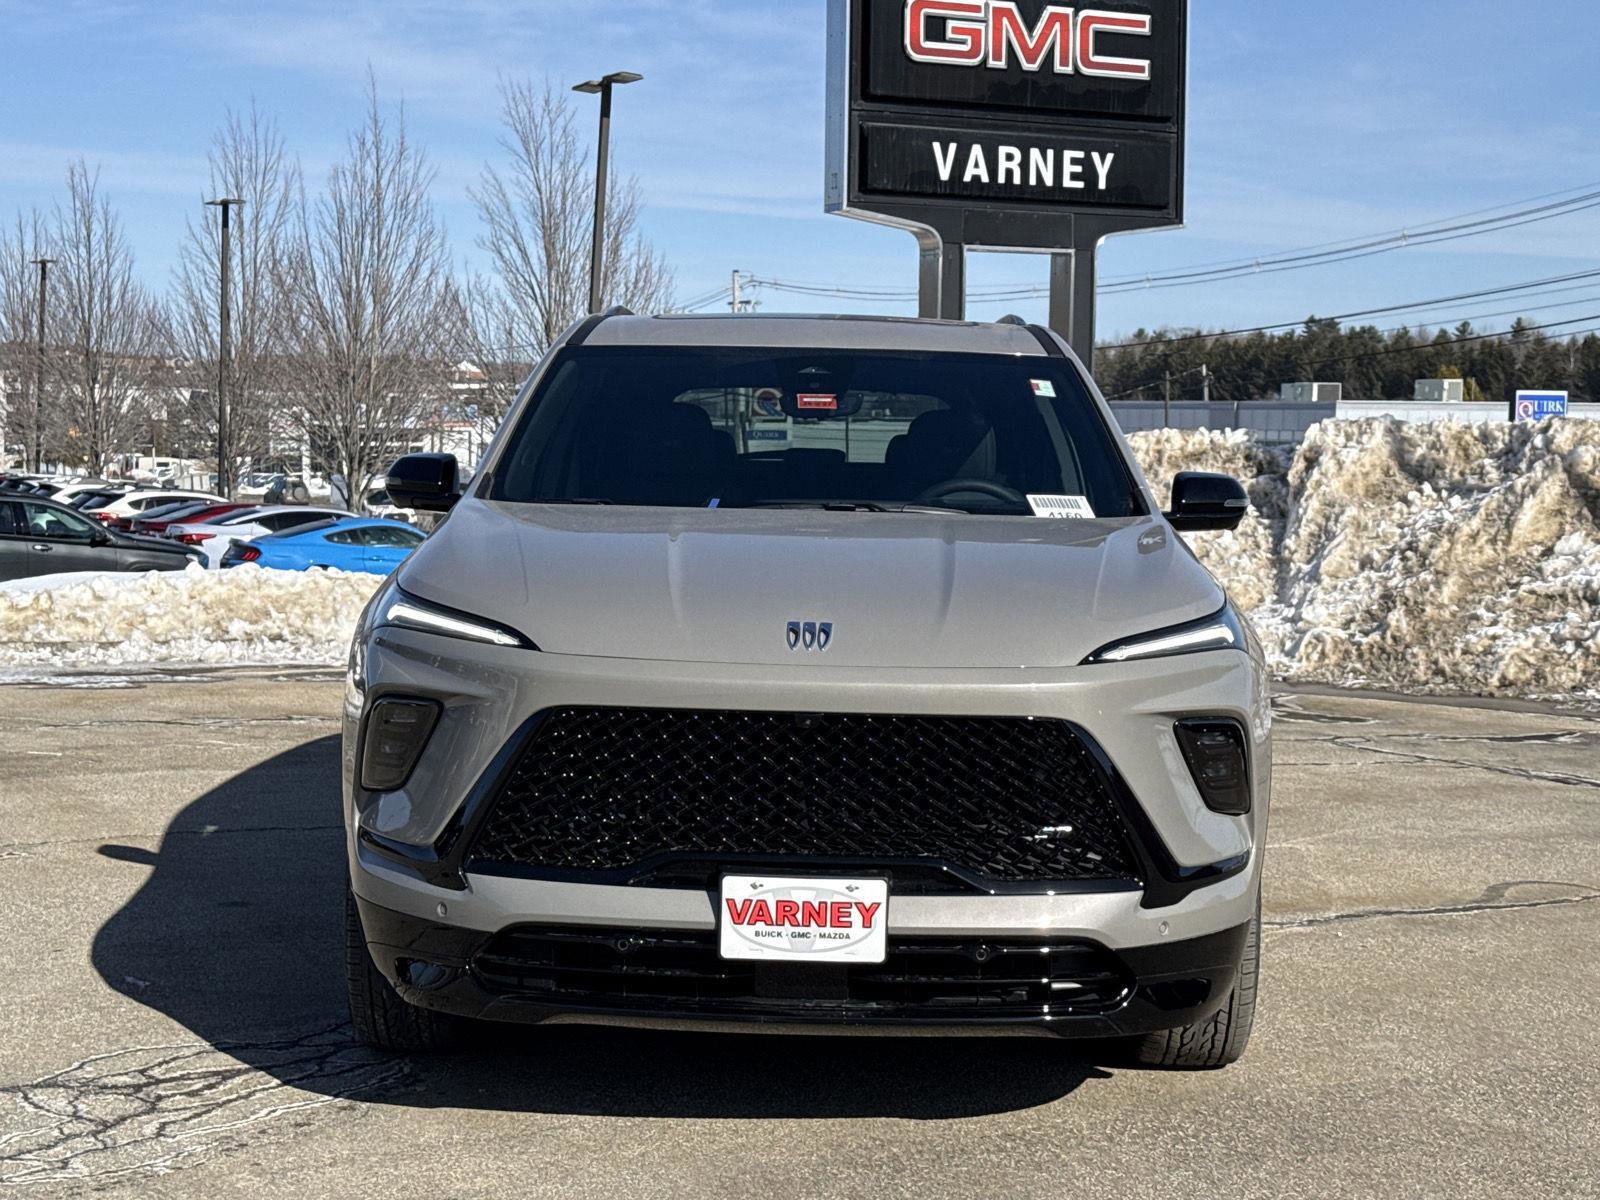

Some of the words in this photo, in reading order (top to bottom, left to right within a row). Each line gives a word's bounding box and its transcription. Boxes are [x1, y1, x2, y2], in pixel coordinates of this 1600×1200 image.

[905, 0, 1151, 80] GMC
[932, 141, 1115, 190] VARNEY
[725, 898, 881, 928] VARNEY
[754, 930, 783, 938] BUICK
[790, 931, 812, 939] GMC
[818, 931, 851, 940] MAZDA
